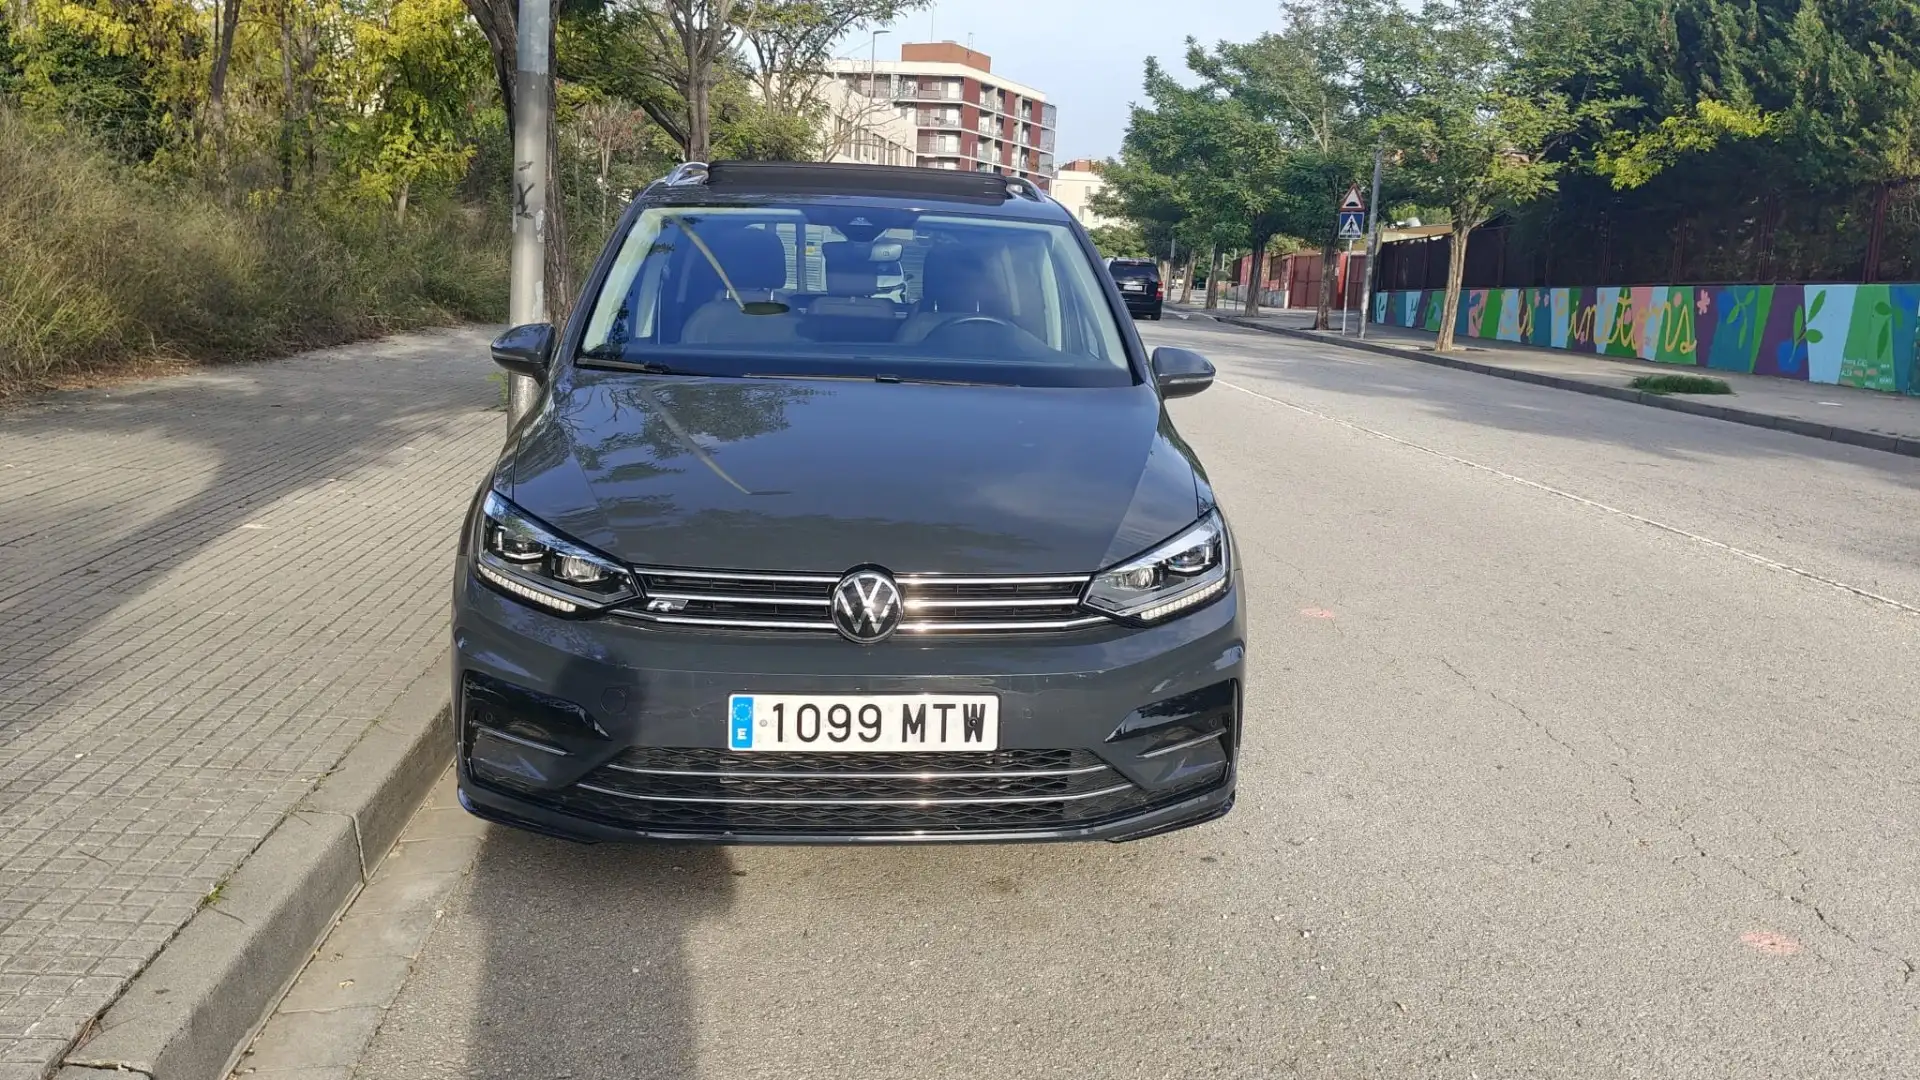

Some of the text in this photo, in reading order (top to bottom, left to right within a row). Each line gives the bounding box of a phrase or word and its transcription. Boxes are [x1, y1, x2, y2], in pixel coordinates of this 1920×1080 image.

[736, 728, 747, 740] E
[772, 703, 986, 743] 1099 MTW
